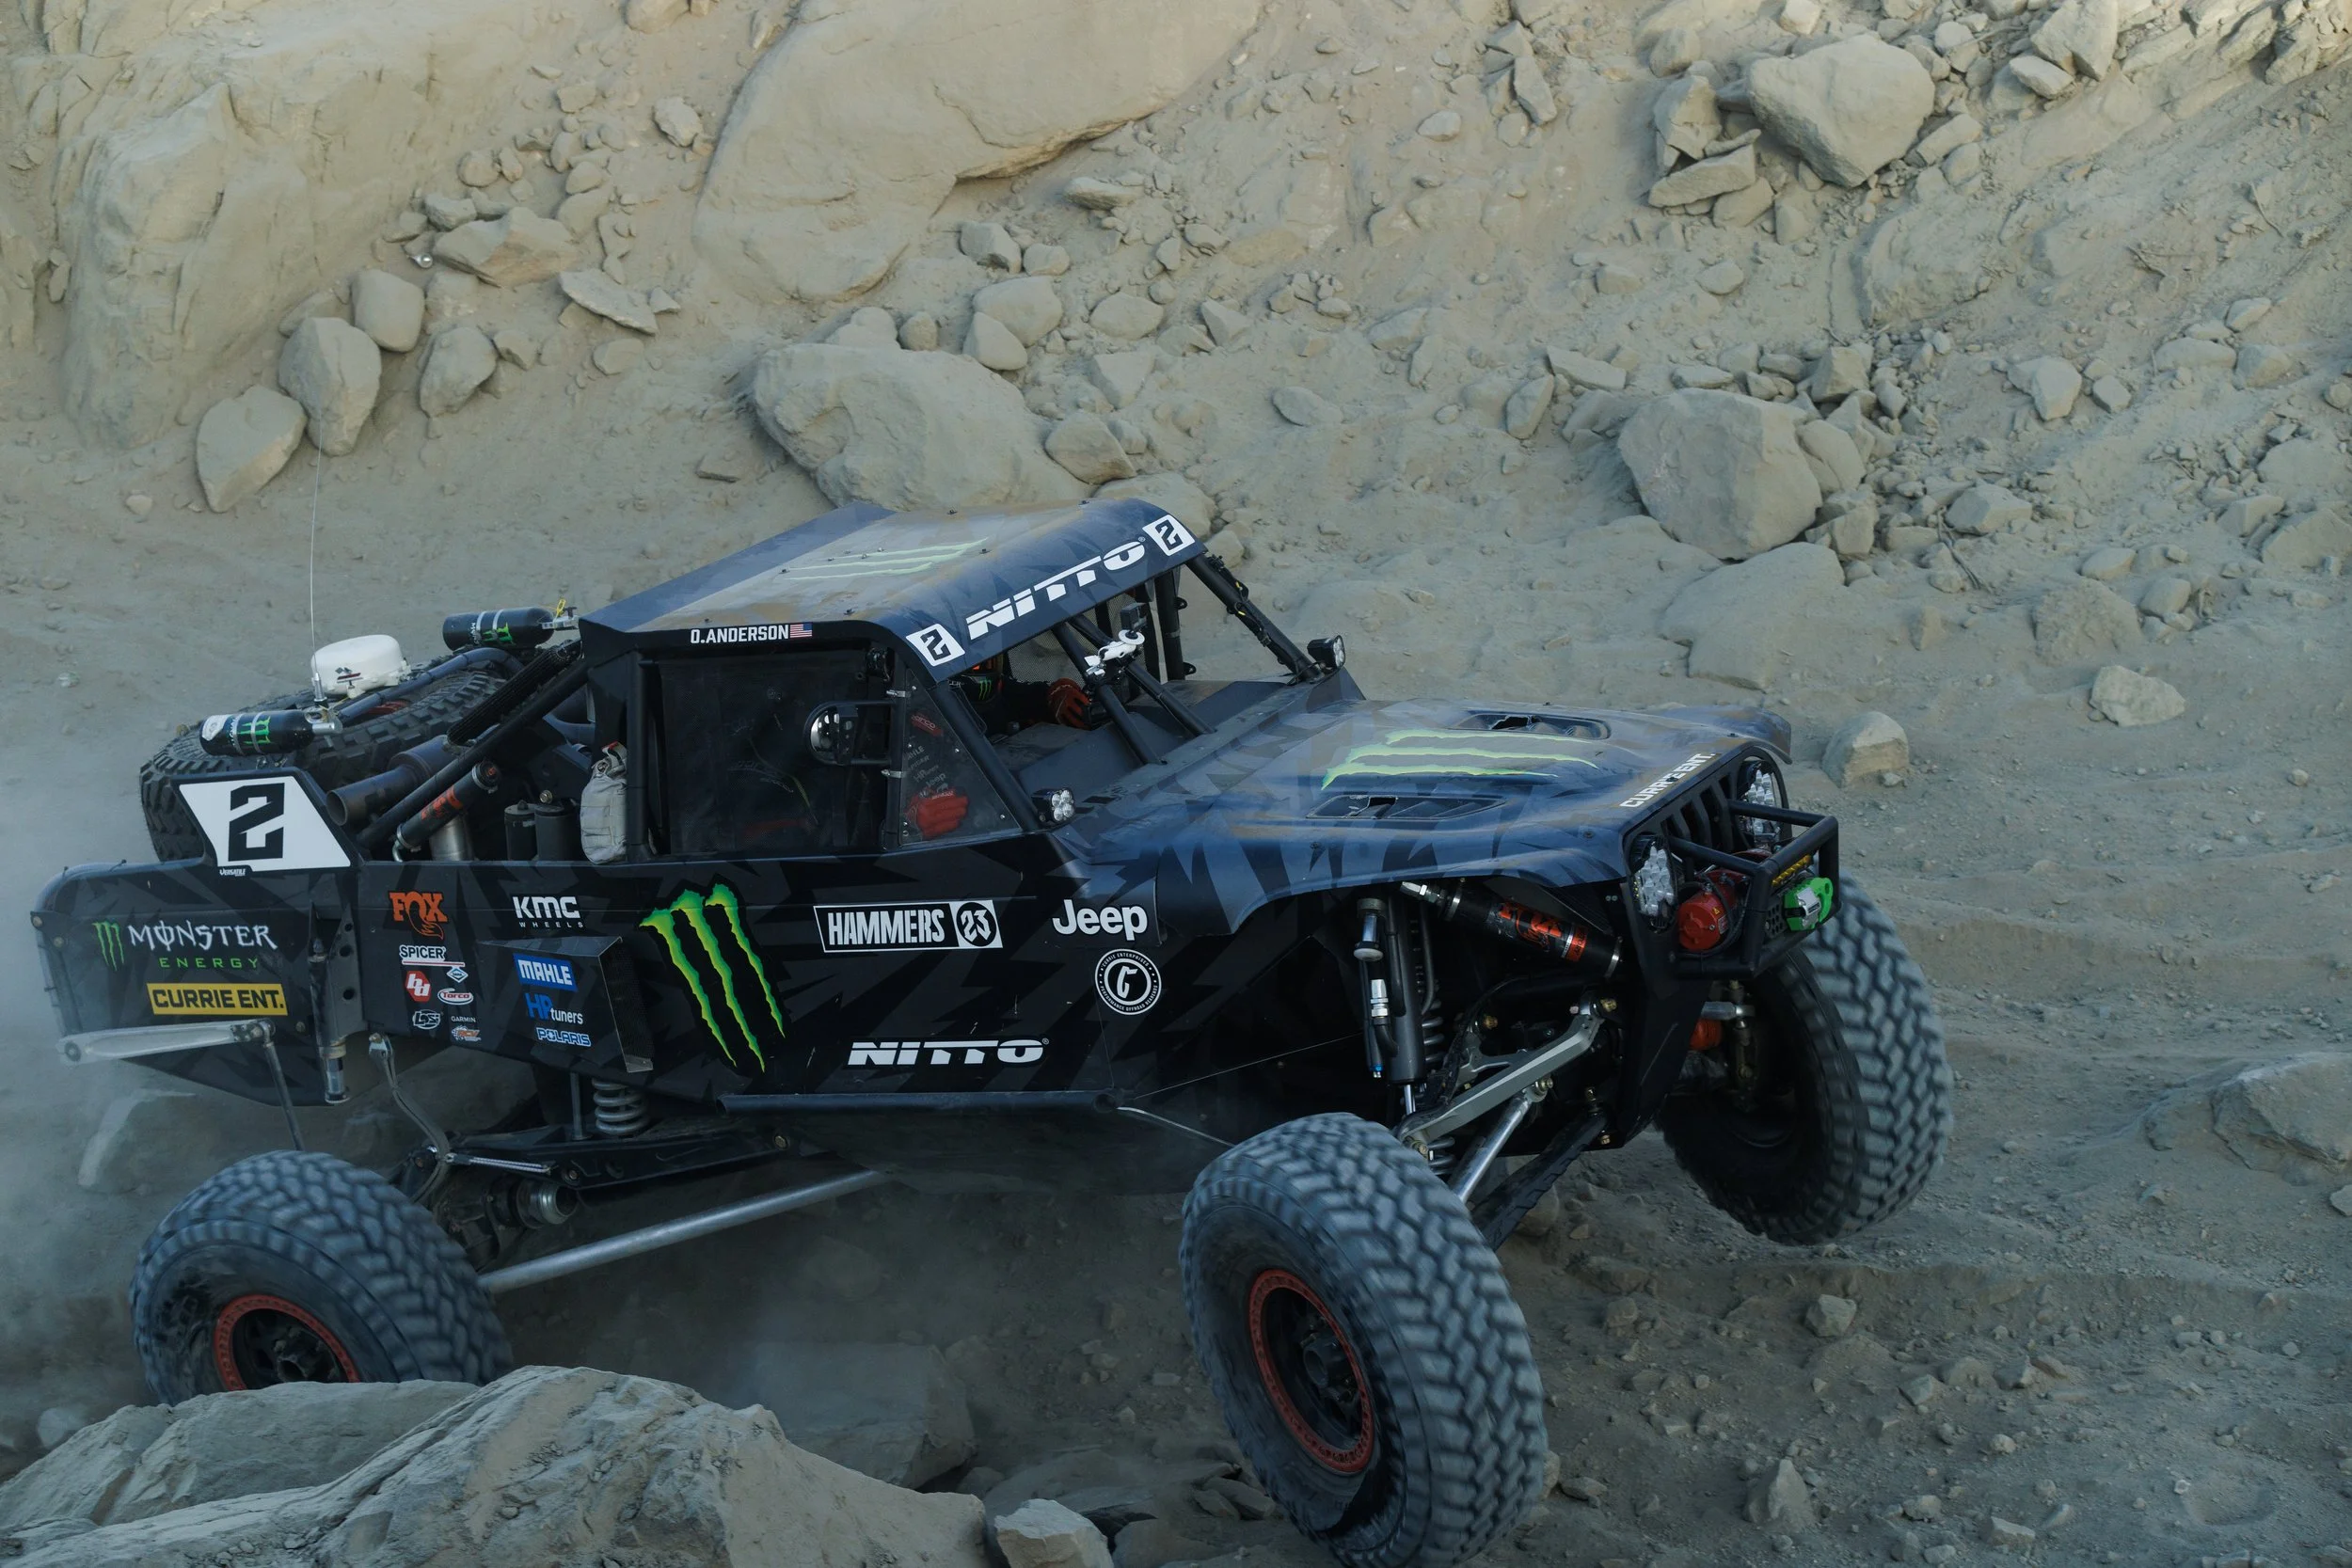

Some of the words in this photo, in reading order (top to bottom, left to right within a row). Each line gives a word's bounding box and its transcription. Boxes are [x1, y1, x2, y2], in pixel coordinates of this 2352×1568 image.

[1154, 519, 1184, 551] 2
[965, 541, 1146, 641] NITTO
[919, 627, 952, 661] 2
[1673, 752, 1716, 772] ENT.
[228, 782, 285, 863] 2
[389, 891, 448, 940] FOX
[512, 896, 580, 919] KMC
[1052, 898, 1149, 941] Jeep
[126, 919, 278, 952] MONSTER
[827, 909, 946, 945] HAMMERS
[960, 909, 992, 943] 23
[158, 957, 259, 969] ENERGY
[400, 946, 444, 959] SPICER
[517, 958, 573, 986] MAHLE
[152, 989, 233, 1008] CURRIE
[238, 989, 284, 1009] ENT.
[536, 1027, 592, 1047] POLARIS
[847, 1038, 1044, 1066] NITTO
